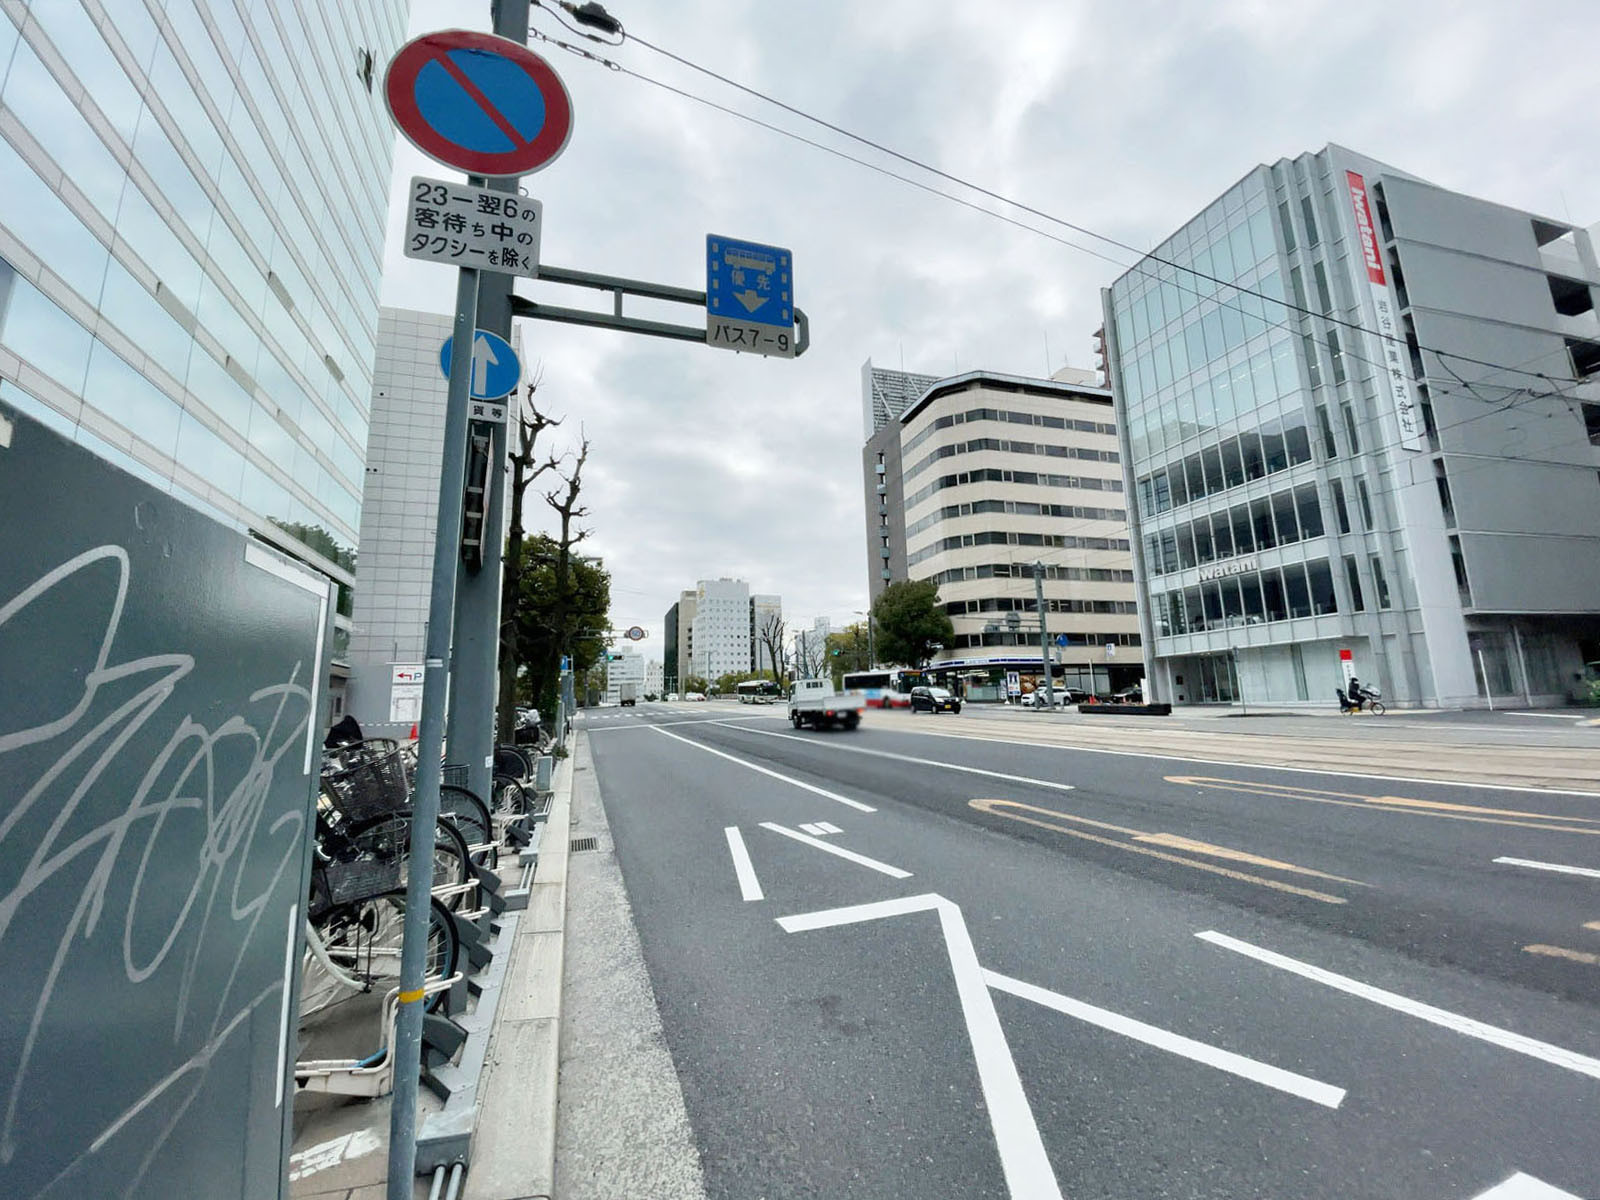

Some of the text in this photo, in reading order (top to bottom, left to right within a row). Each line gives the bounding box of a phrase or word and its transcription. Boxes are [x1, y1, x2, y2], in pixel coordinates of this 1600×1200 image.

[415, 207, 533, 246] 客待ち中の
[1351, 186, 1381, 270] Iwatani
[412, 233, 529, 270] タクシーを除く
